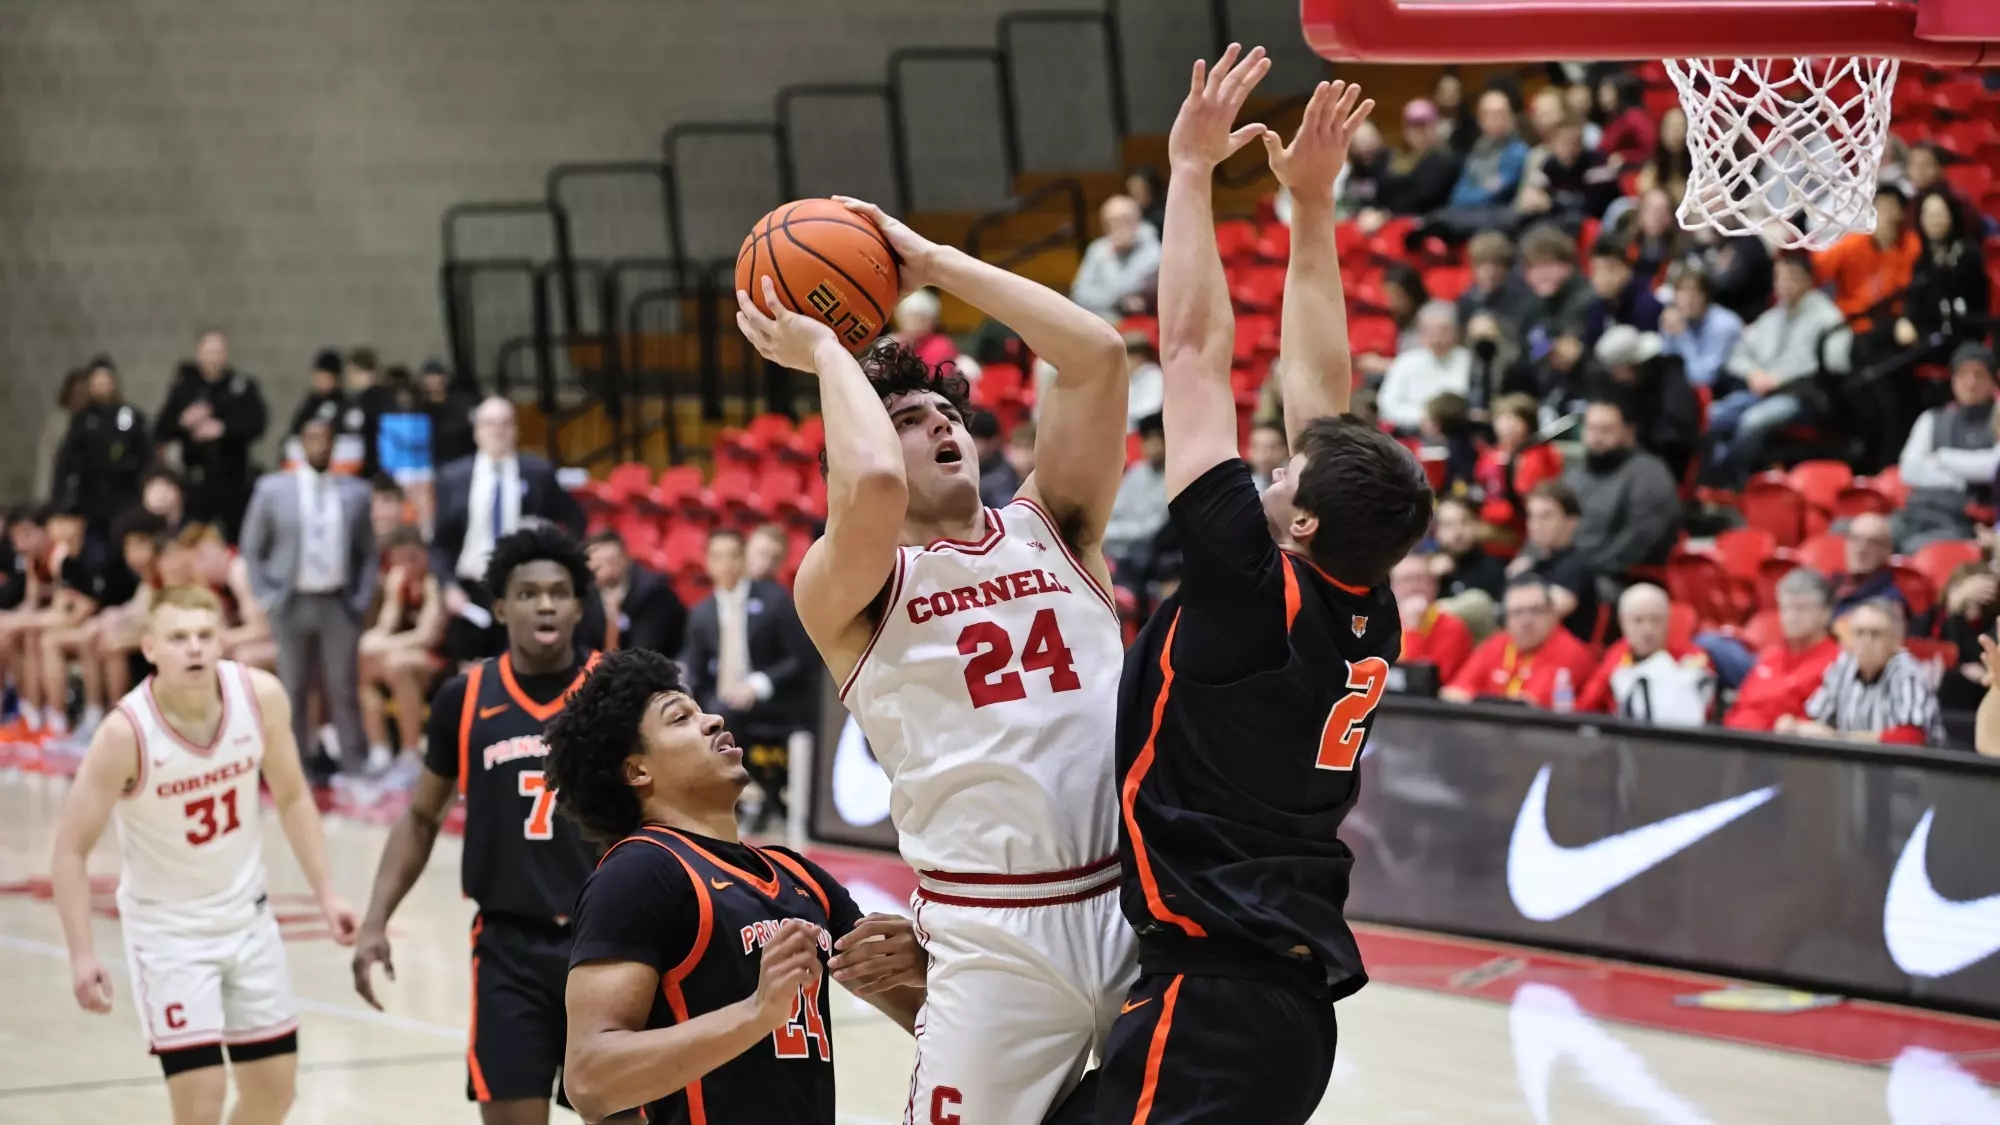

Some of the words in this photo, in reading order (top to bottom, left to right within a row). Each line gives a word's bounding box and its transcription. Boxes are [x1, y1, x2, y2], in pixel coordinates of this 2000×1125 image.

[806, 283, 871, 346] ELITE
[906, 568, 1073, 625] CORNELL
[956, 608, 1081, 709] 24
[1315, 656, 1389, 771] 2
[184, 786, 241, 846] 31
[518, 770, 560, 840] 7
[165, 1003, 187, 1029] C
[930, 1085, 962, 1125] C
